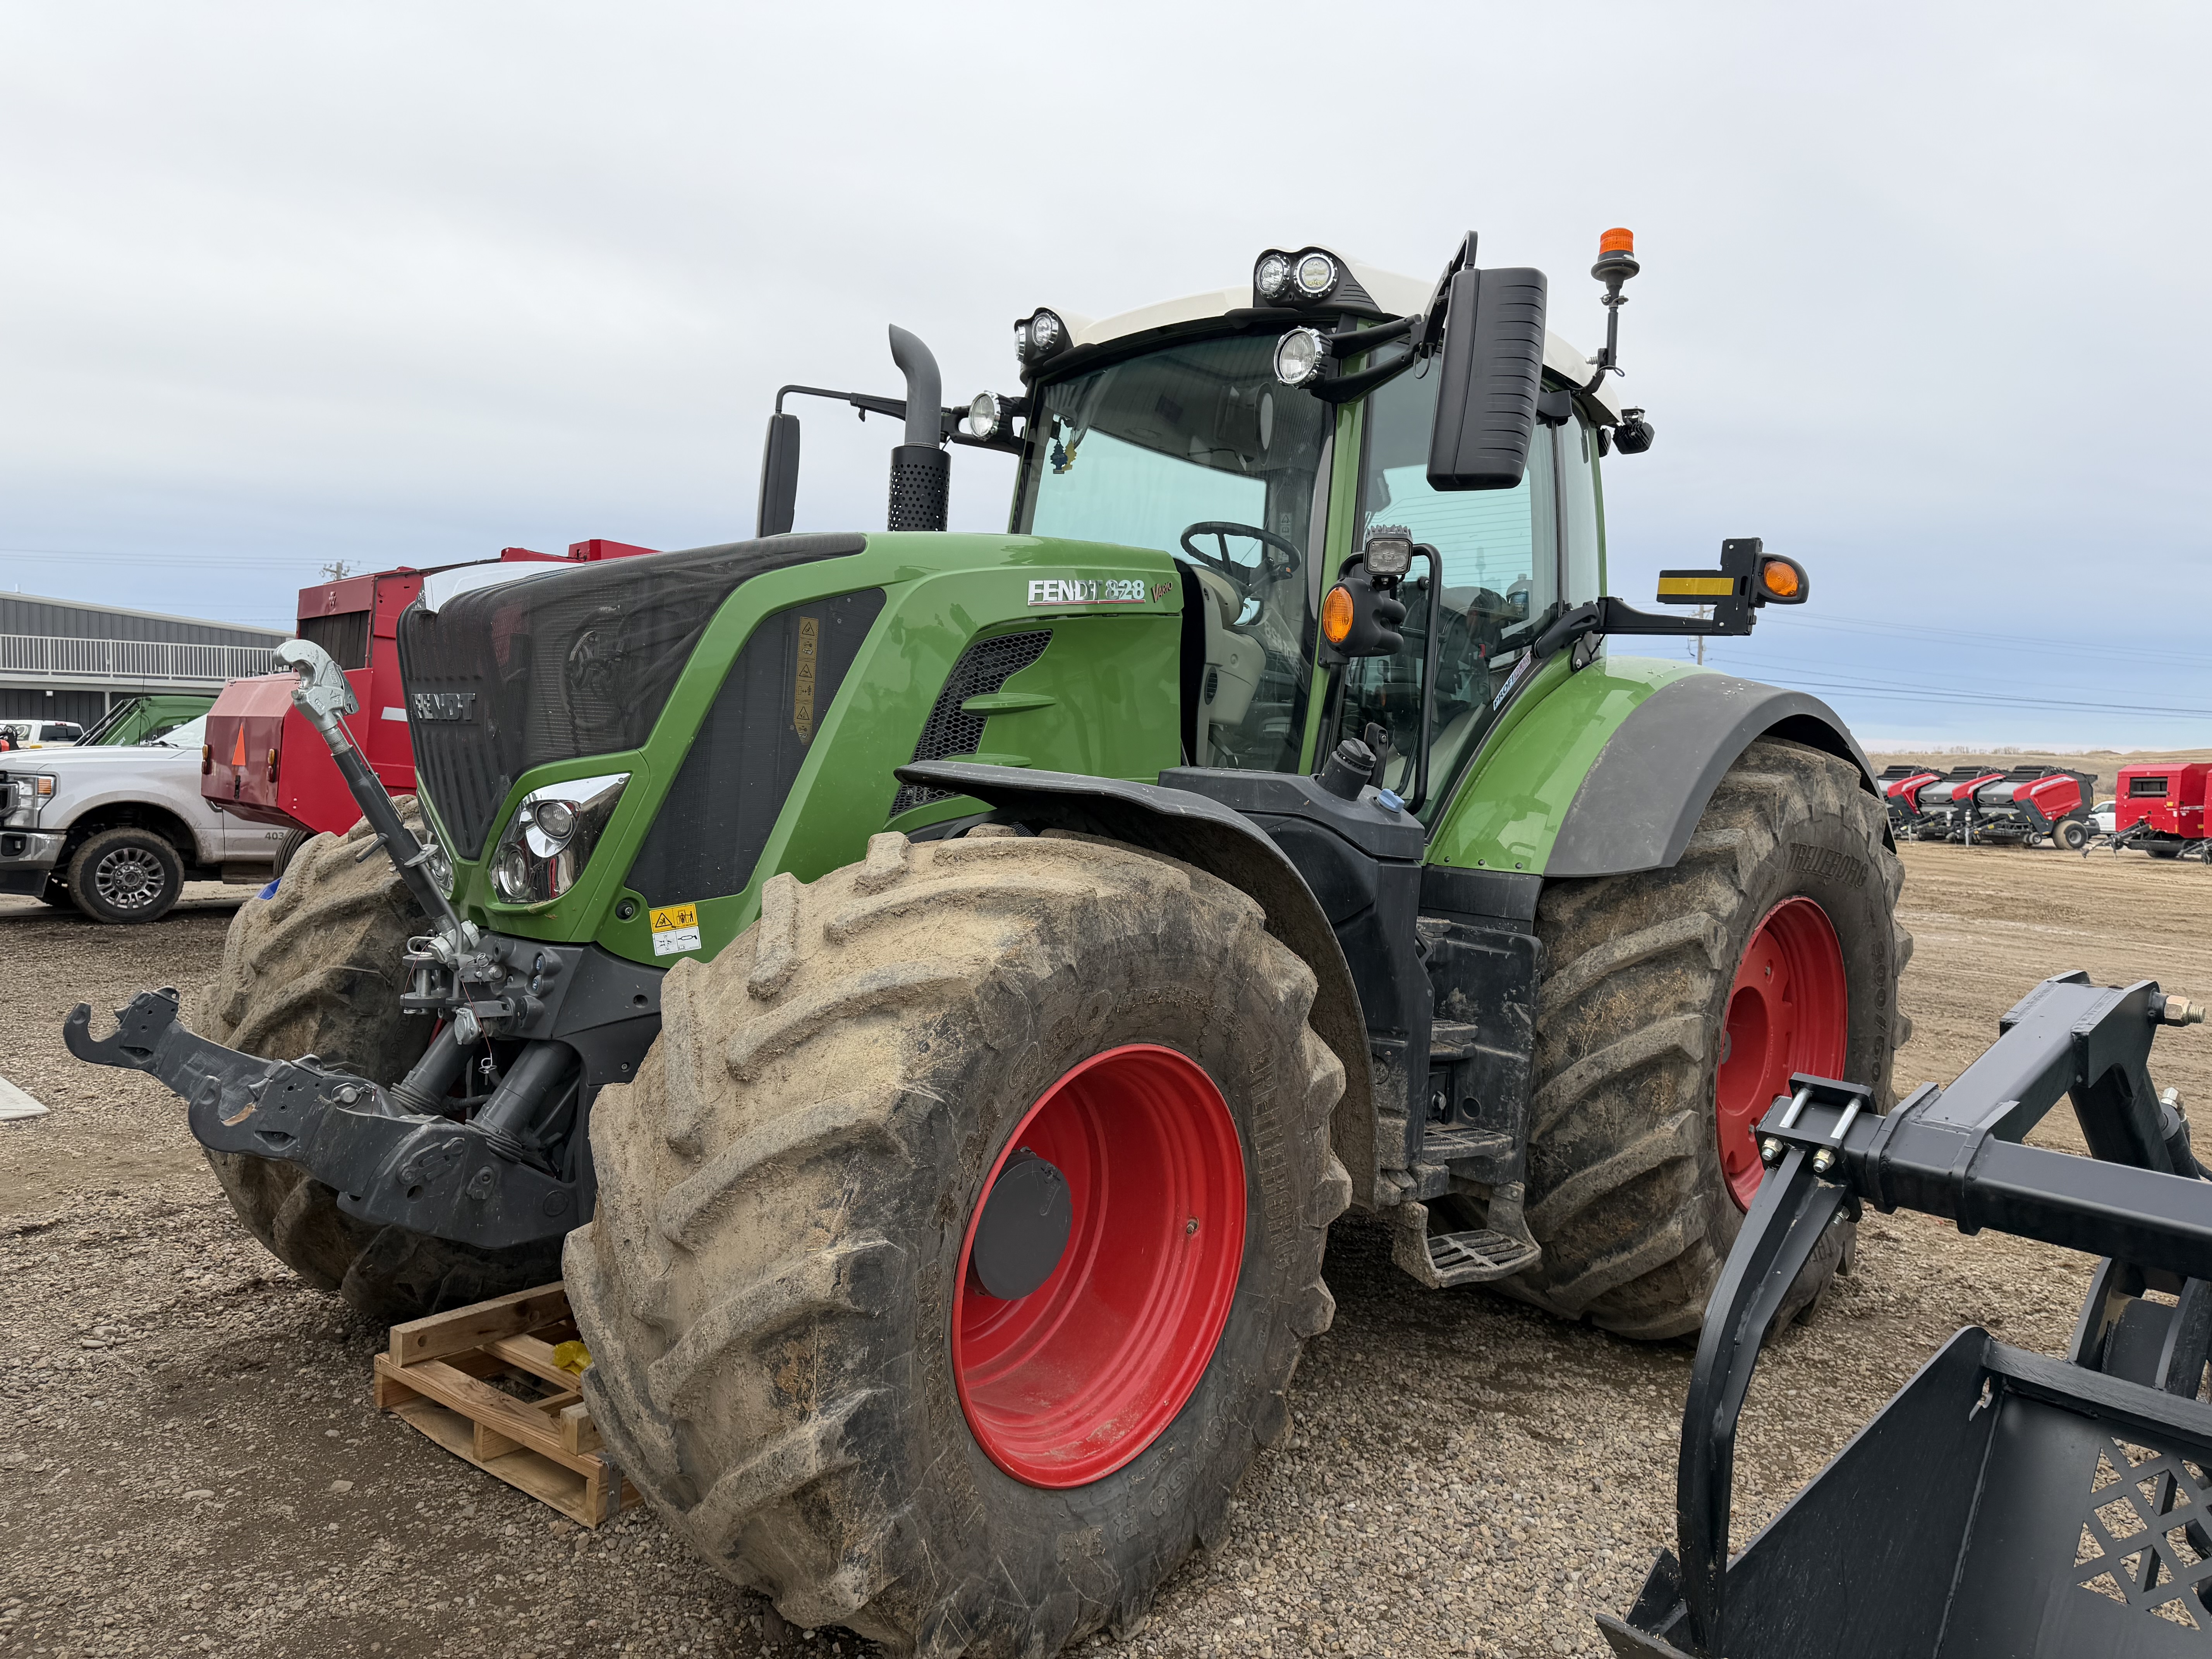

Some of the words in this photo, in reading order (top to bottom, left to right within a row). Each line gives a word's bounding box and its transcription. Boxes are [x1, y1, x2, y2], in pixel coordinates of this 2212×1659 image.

[1029, 580, 1103, 601] FENDT
[1105, 580, 1145, 600] 828
[1151, 581, 1173, 603] VARIO
[411, 693, 476, 720] FENDT
[265, 832, 284, 840] 403
[1787, 842, 1869, 889] TRELLEBORG
[1248, 1044, 1299, 1271] TRELLEBORG
